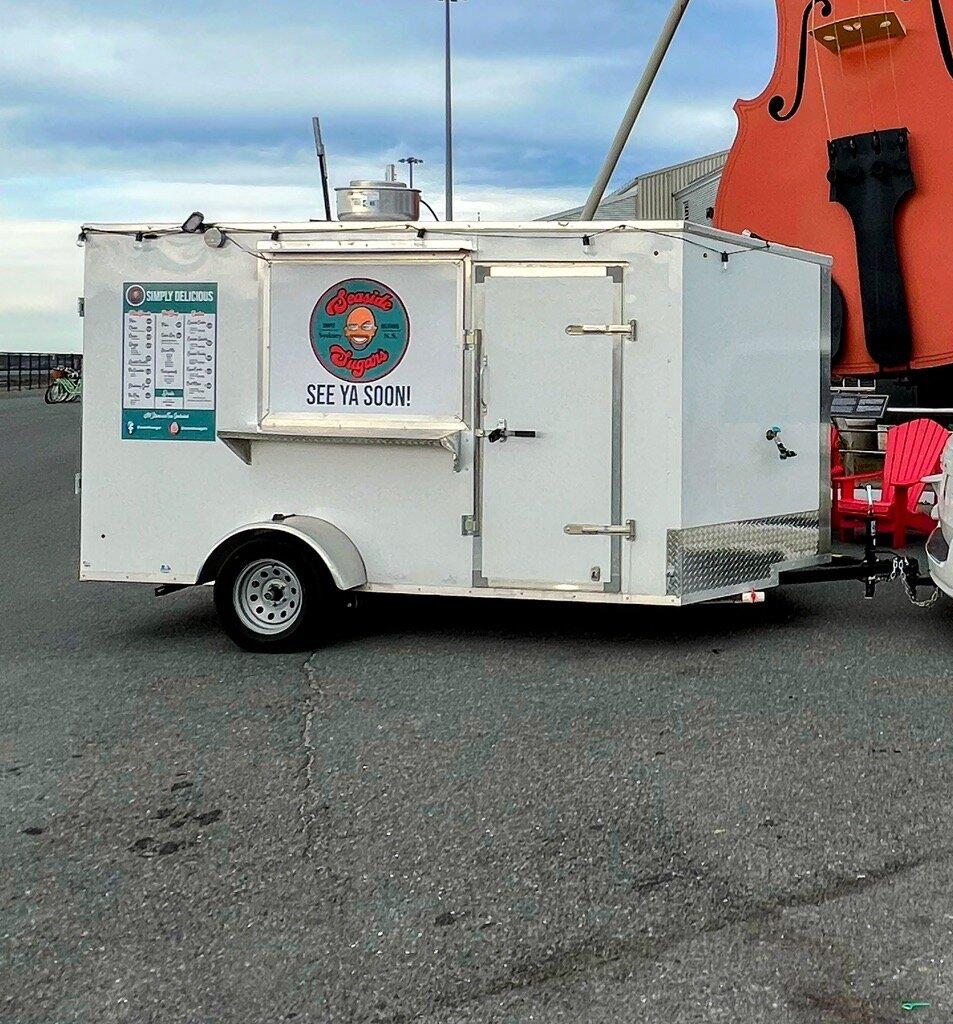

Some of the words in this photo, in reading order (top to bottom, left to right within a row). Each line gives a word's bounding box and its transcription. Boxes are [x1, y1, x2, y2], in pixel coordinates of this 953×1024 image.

[146, 290, 173, 302] SIMPLY
[174, 290, 214, 302] DELICIOUS
[325, 287, 393, 316] Seaside
[329, 344, 390, 378] Sugars
[306, 384, 335, 405] SEE
[340, 384, 358, 405] YA
[364, 385, 411, 407] SOON!
